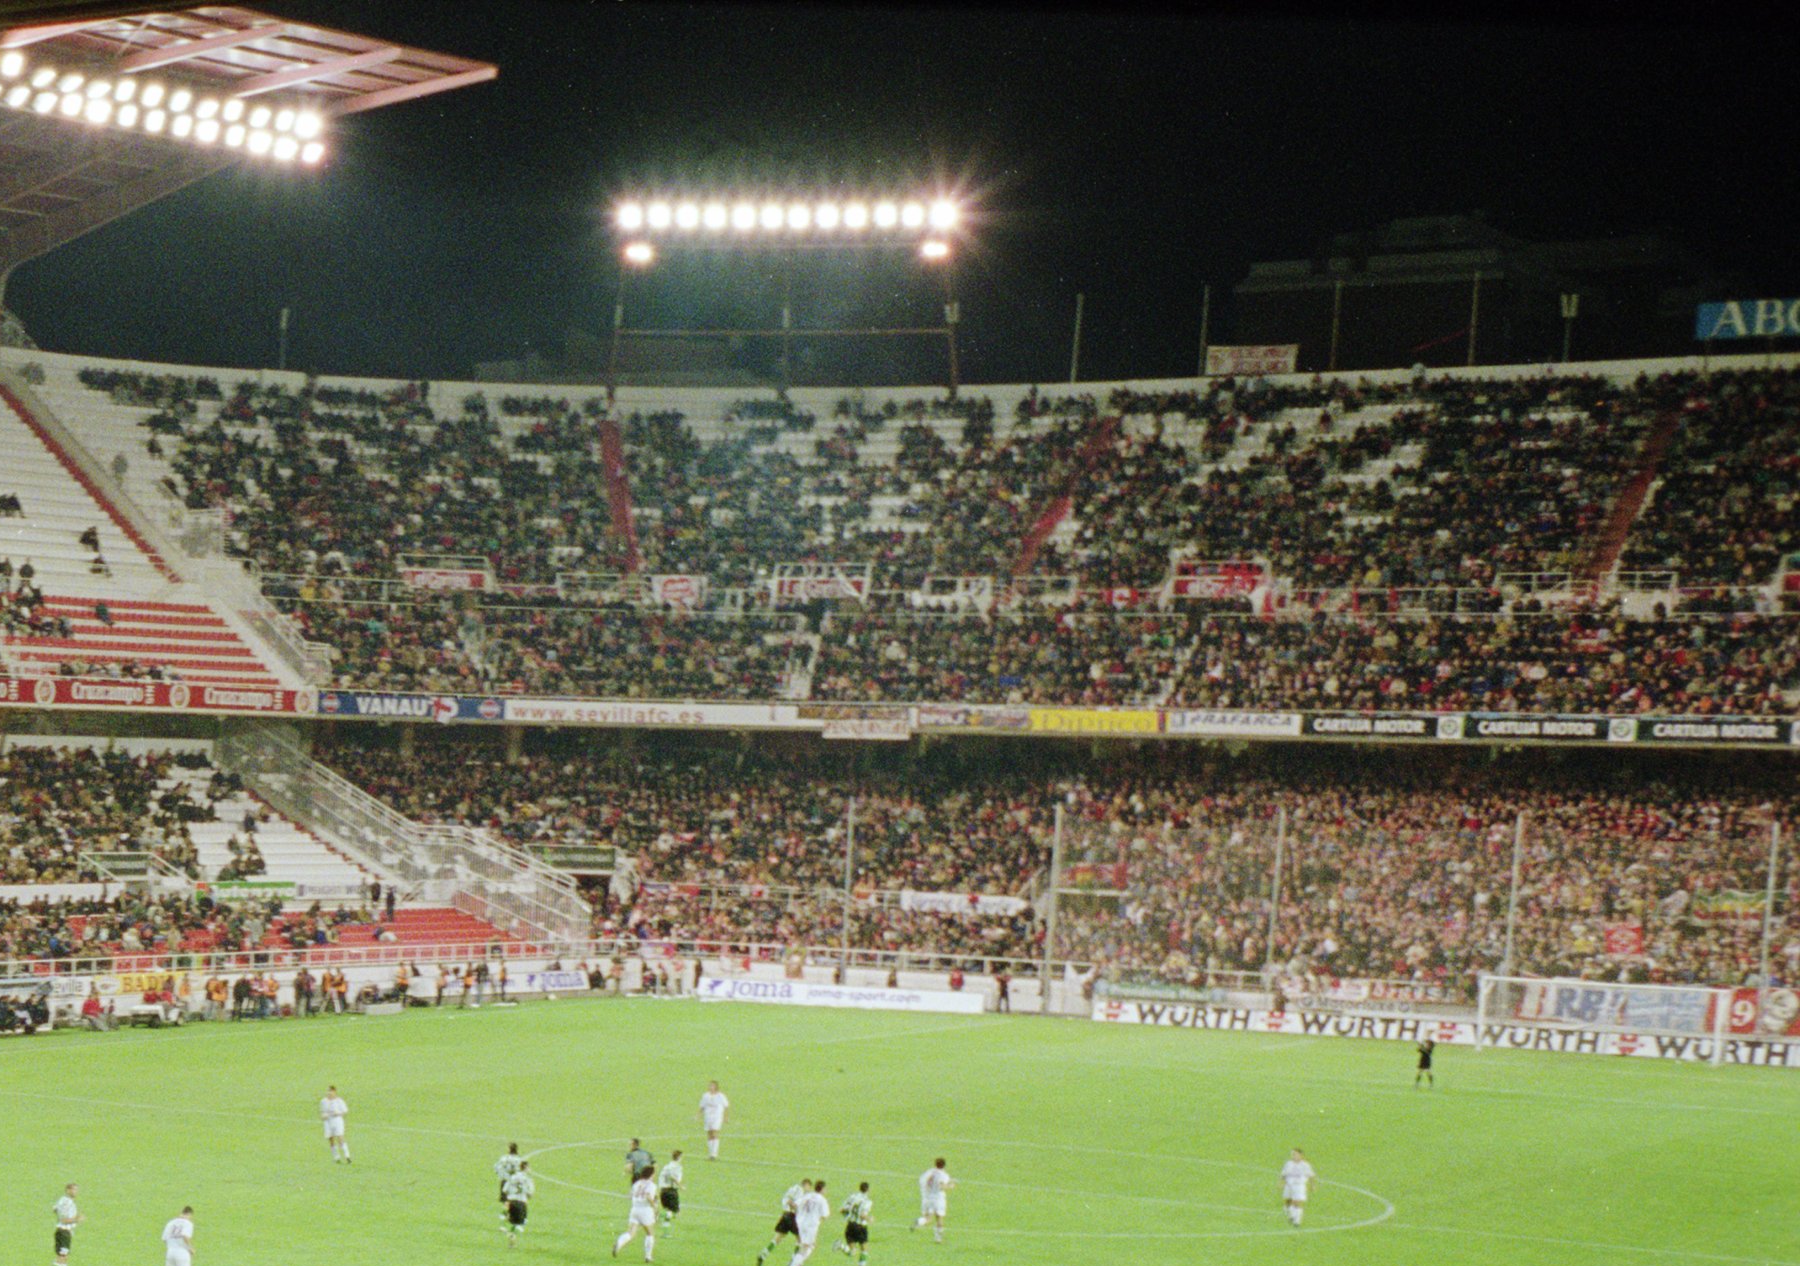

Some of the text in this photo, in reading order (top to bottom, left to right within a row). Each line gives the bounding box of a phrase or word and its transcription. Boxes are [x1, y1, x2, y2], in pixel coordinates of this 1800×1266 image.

[1374, 719, 1425, 734] MOTOR
[1542, 721, 1596, 736] MOTOR
[1721, 724, 1778, 739] MOTOR
